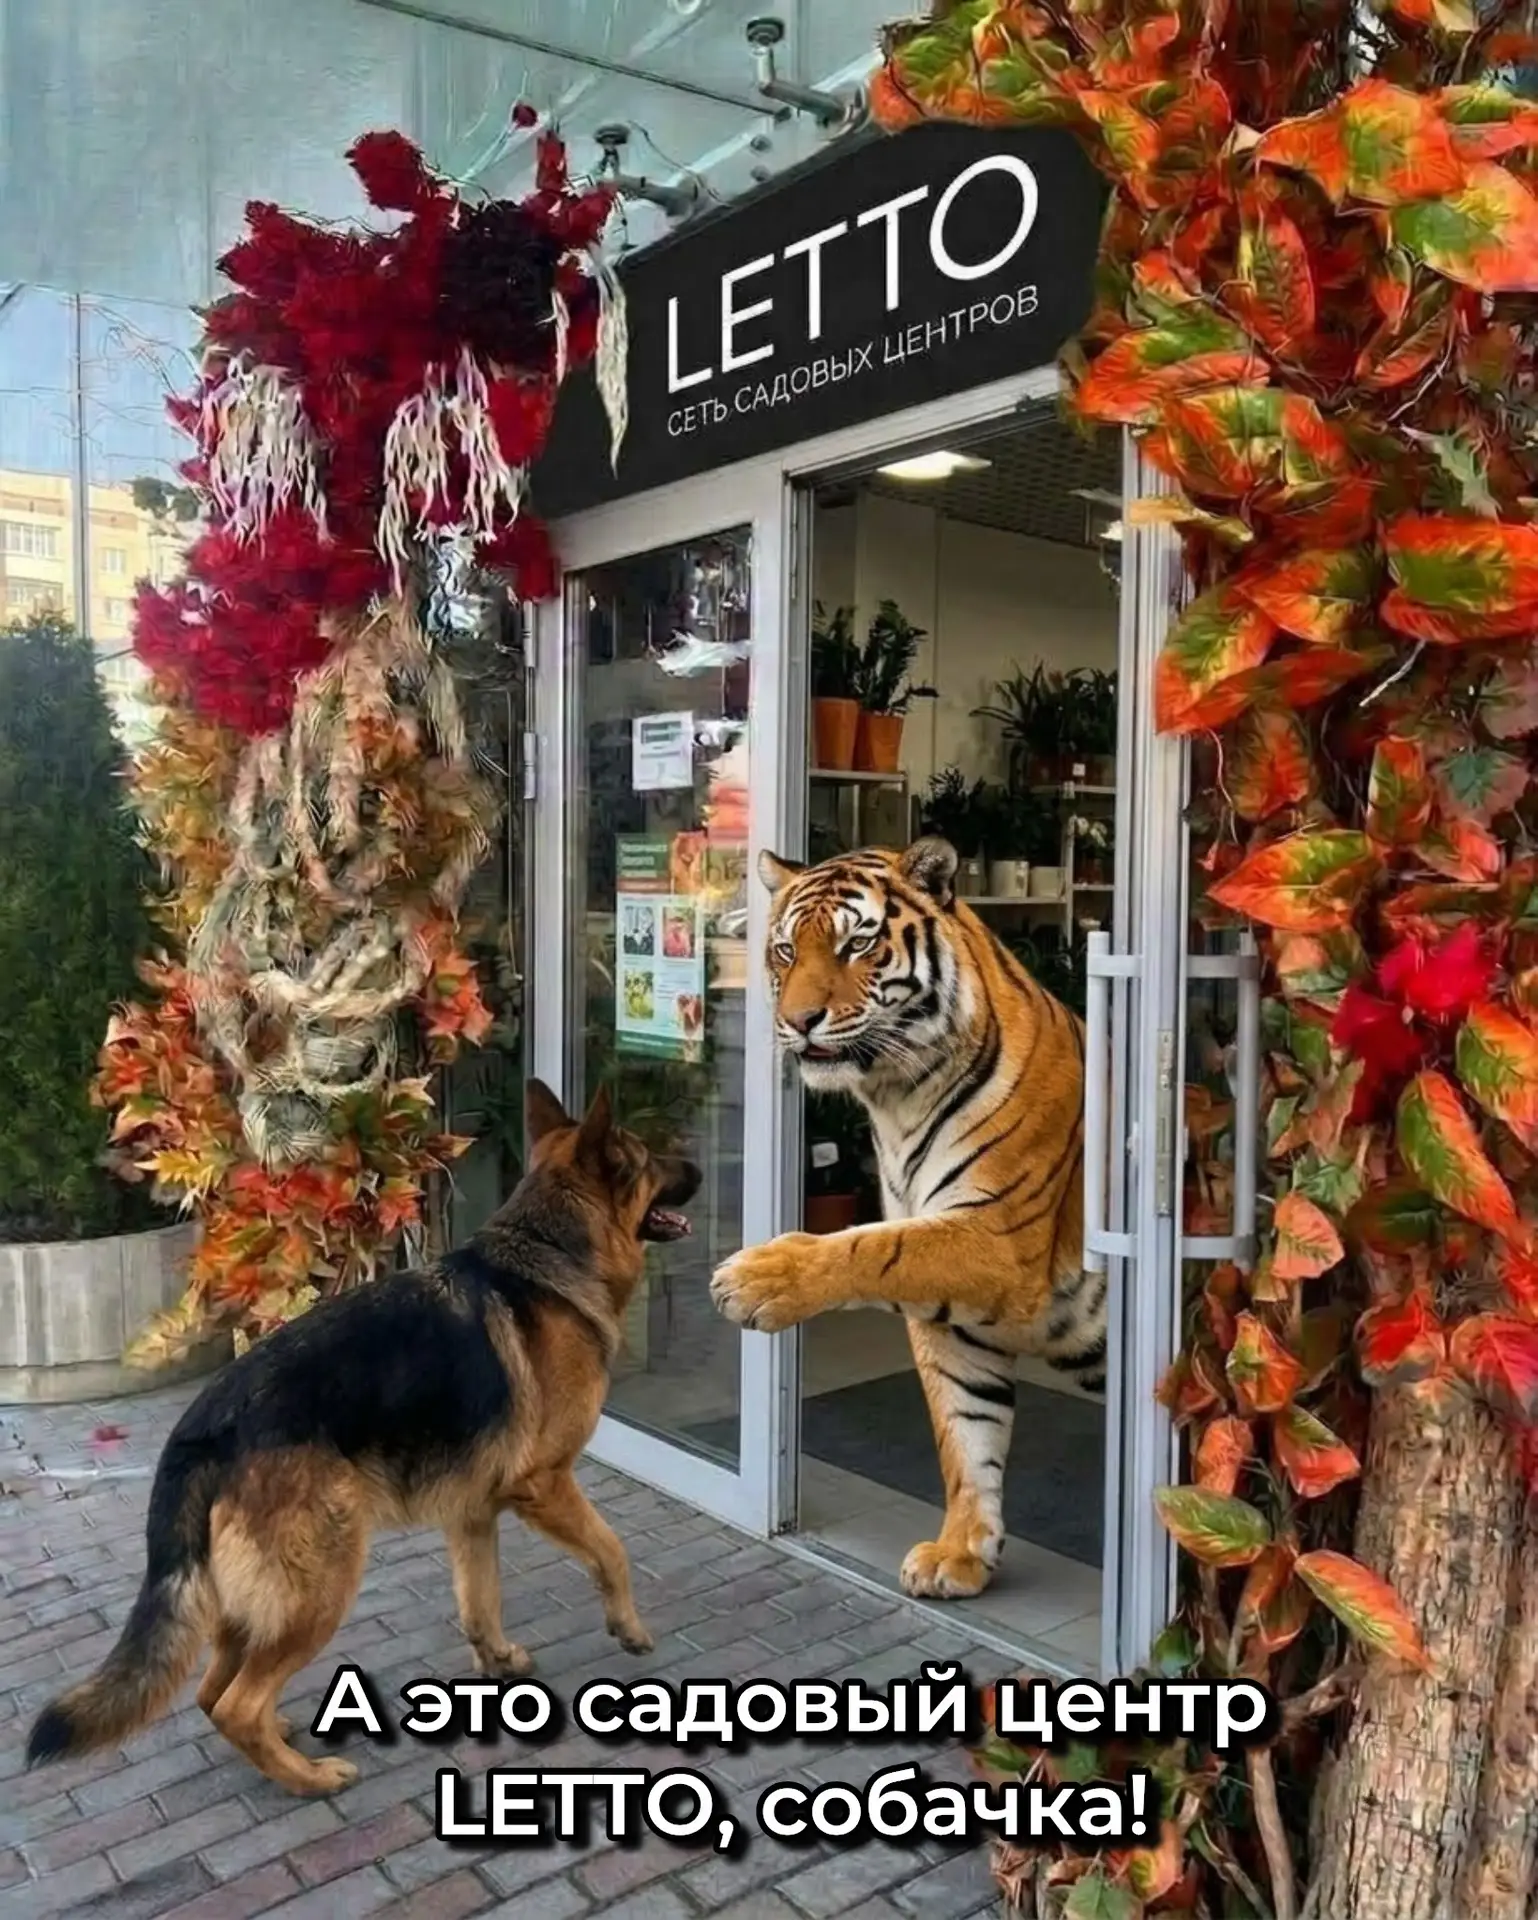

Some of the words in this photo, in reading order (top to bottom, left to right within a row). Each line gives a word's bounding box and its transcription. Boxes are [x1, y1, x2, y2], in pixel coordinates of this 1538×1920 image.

[666, 397, 729, 437] СЕТЬ
[733, 342, 874, 414] САДОВЫХ
[882, 283, 1040, 365] ЦЕНТРОВ
[667, 153, 1040, 394] LETTO
